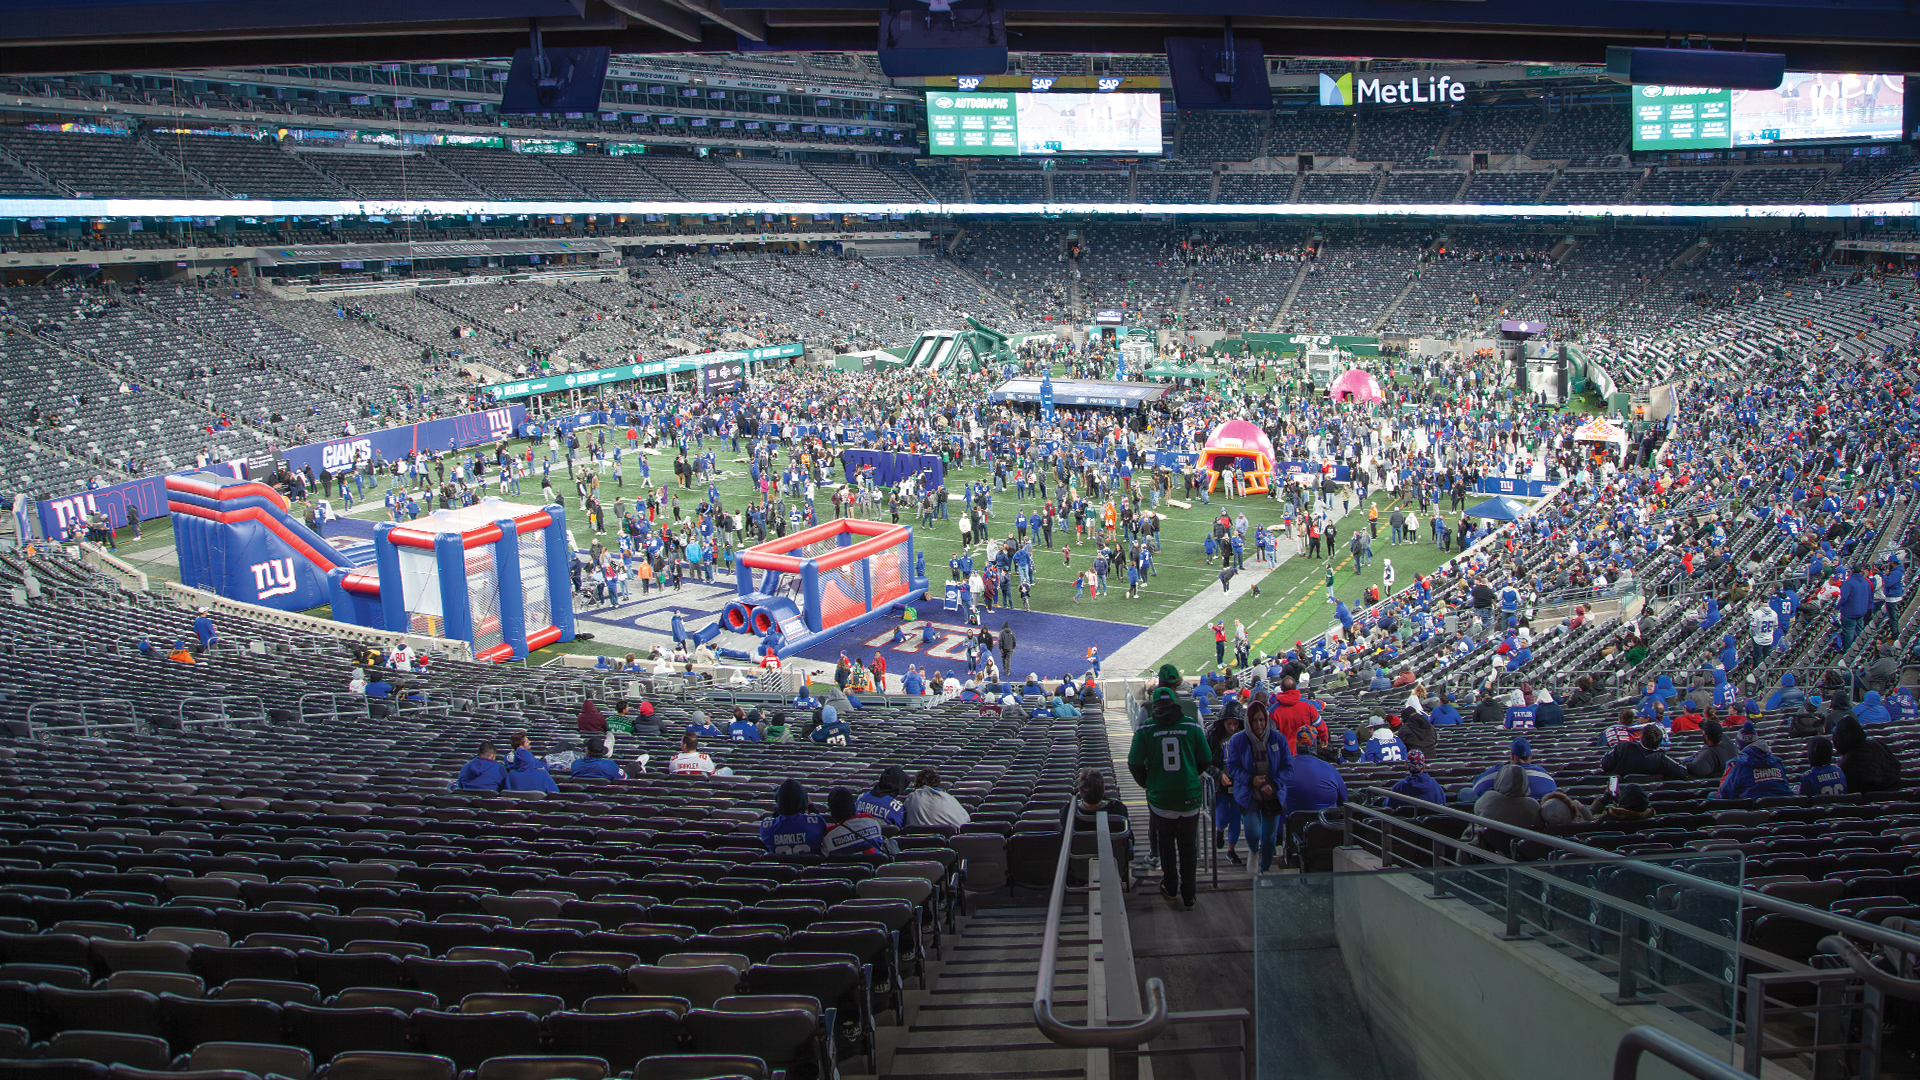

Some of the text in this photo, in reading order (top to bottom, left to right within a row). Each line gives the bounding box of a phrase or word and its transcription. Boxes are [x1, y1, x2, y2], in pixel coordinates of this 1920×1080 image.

[630, 71, 664, 79] WINSTON
[958, 78, 980, 89] SAP
[1031, 79, 1053, 89] SAP
[1098, 79, 1120, 89] SAP
[1357, 75, 1466, 104] MetLife
[954, 97, 1009, 109] AUTOGRAPHS
[295, 249, 331, 257] MetLife
[411, 243, 491, 254] METLIFE STADIUM
[1289, 334, 1332, 345] JETS
[486, 408, 513, 438] ny
[322, 439, 372, 469] GIANTS
[1499, 480, 1514, 492] ny
[250, 557, 297, 600] ny
[1781, 601, 1791, 614] 93
[1761, 620, 1773, 633] 26
[395, 652, 405, 663] 80
[1161, 737, 1181, 771] 8
[1381, 746, 1402, 761] 26
[1753, 767, 1783, 779] GIANTS
[1817, 771, 1841, 783] BARKLEY
[857, 800, 891, 819] BARKLEY
[773, 832, 806, 845] BARKLEY
[833, 834, 857, 846] TOMMY
